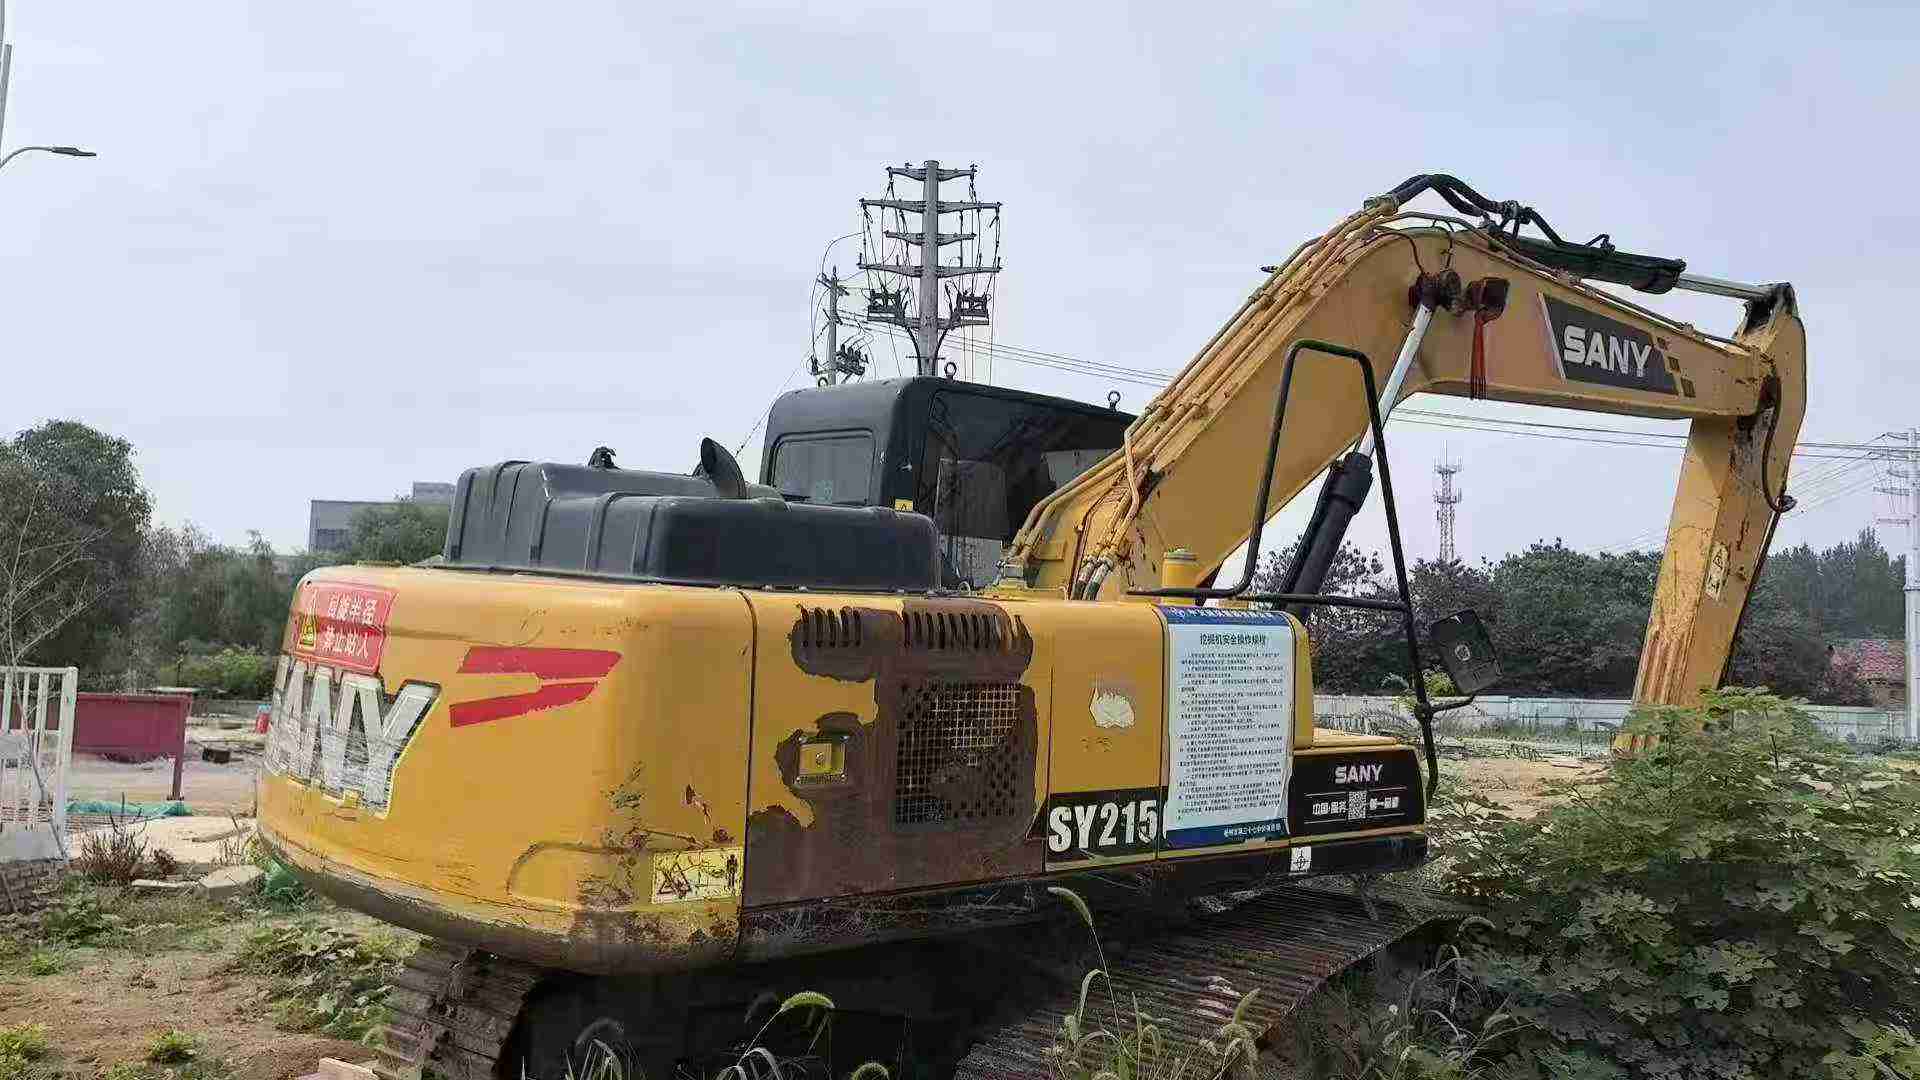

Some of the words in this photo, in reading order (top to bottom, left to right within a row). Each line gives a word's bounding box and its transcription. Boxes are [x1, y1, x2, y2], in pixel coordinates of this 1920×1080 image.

[1564, 324, 1651, 377] SANY
[1335, 764, 1383, 784] SANY
[1049, 800, 1168, 852] SY215
